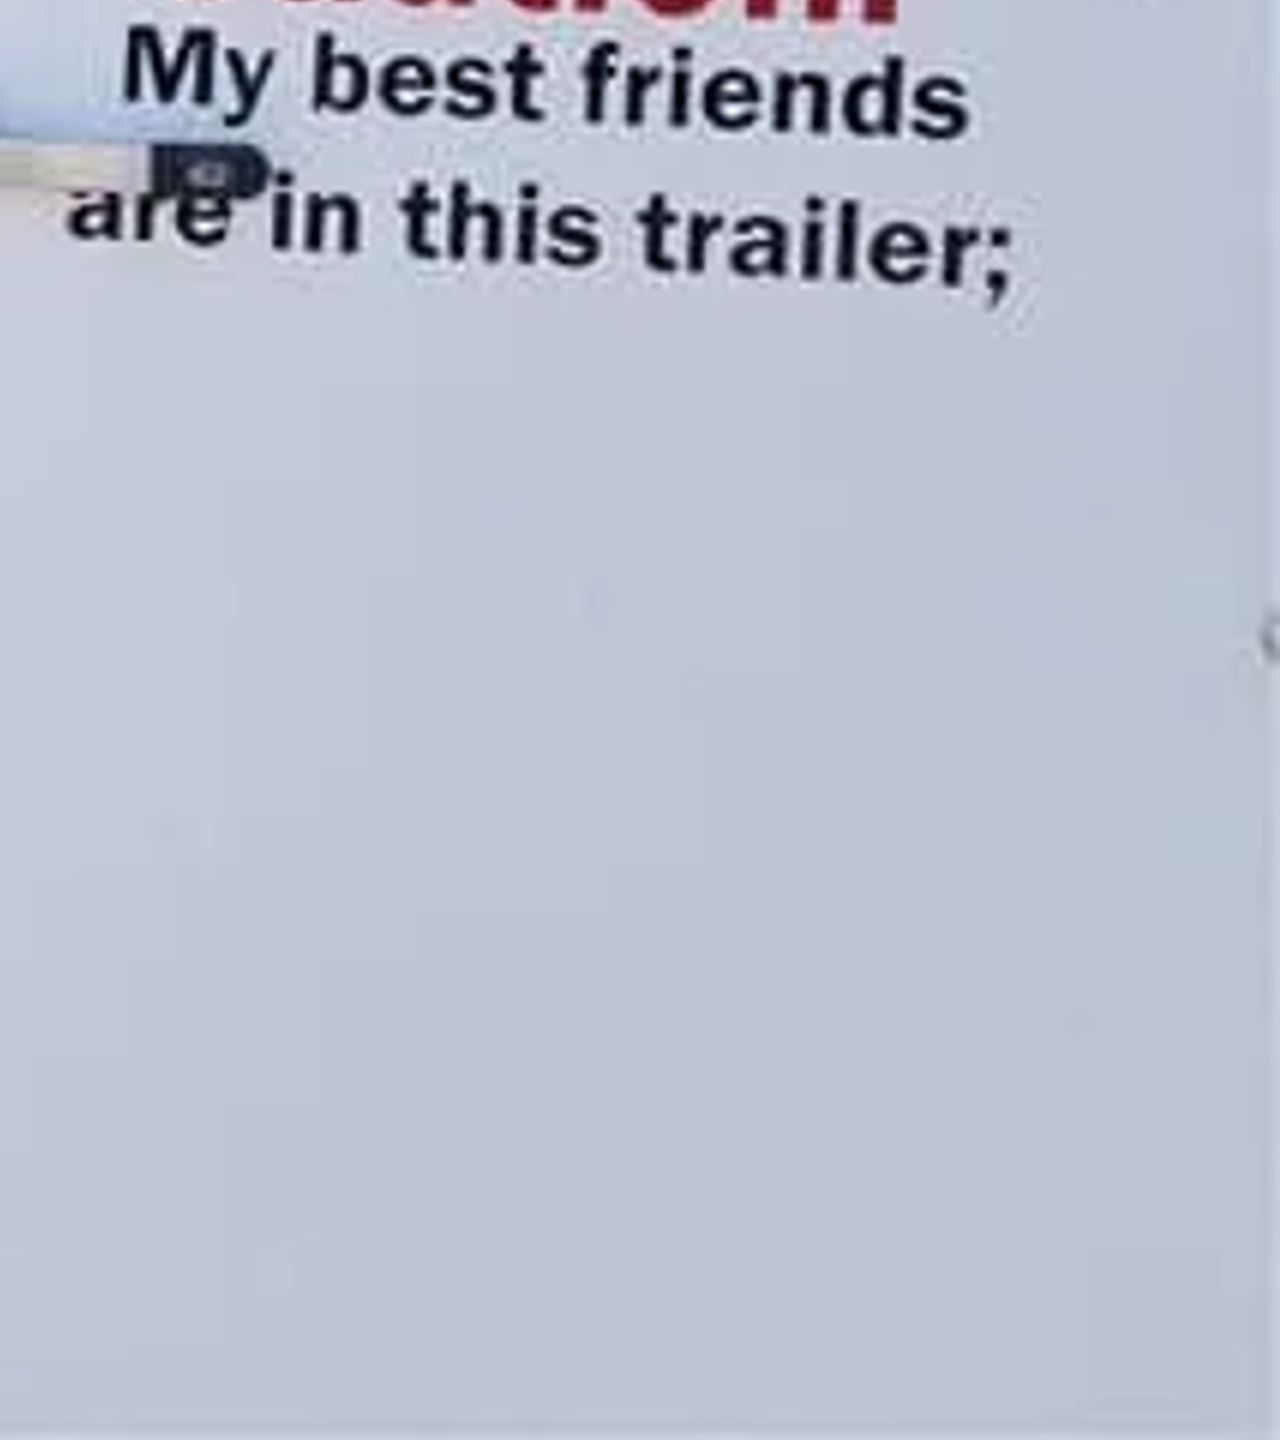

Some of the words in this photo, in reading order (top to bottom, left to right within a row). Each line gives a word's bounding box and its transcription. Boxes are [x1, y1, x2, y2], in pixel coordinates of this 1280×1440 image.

[123, 24, 275, 129] My
[312, 31, 547, 124] best
[581, 39, 970, 141] friends
[66, 188, 233, 248] are
[271, 169, 361, 256] in
[398, 180, 602, 269] this
[635, 192, 1012, 306] trailer;
